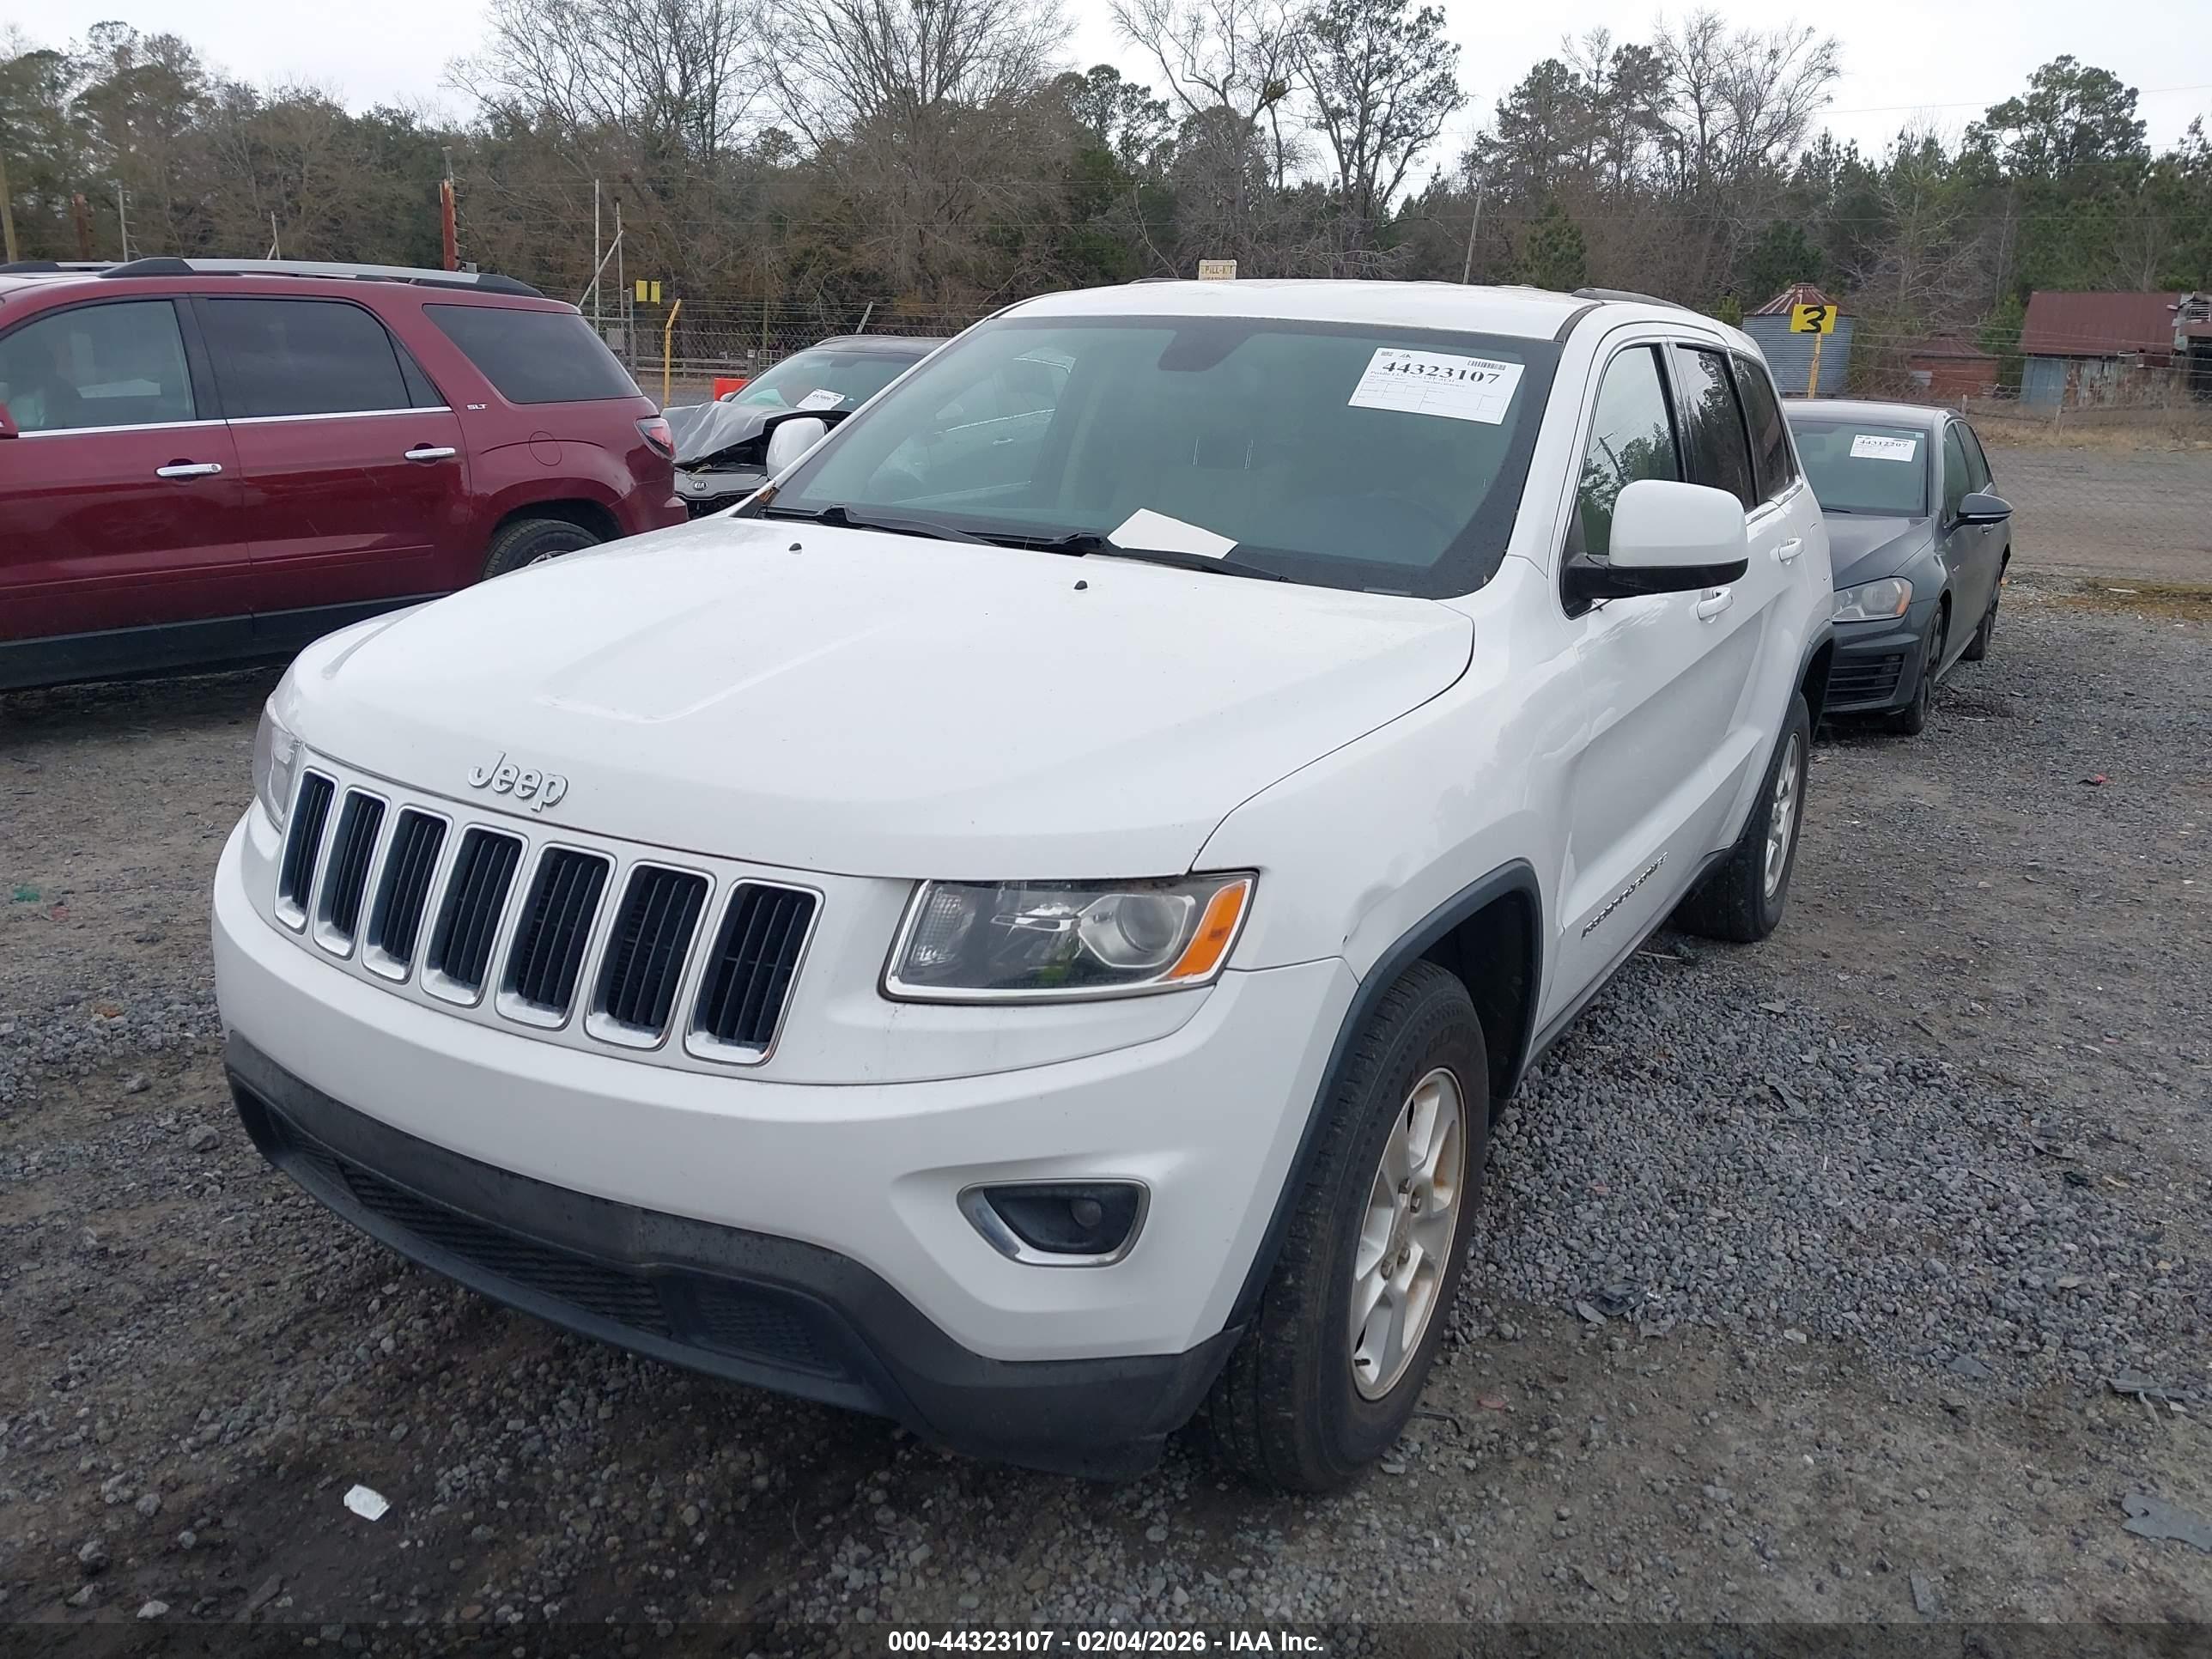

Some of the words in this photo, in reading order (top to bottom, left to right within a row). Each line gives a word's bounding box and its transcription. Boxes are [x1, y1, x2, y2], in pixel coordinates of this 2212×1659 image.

[1801, 305, 1827, 332] 3
[1382, 361, 1500, 385] 44323107
[468, 750, 569, 813] Jeep
